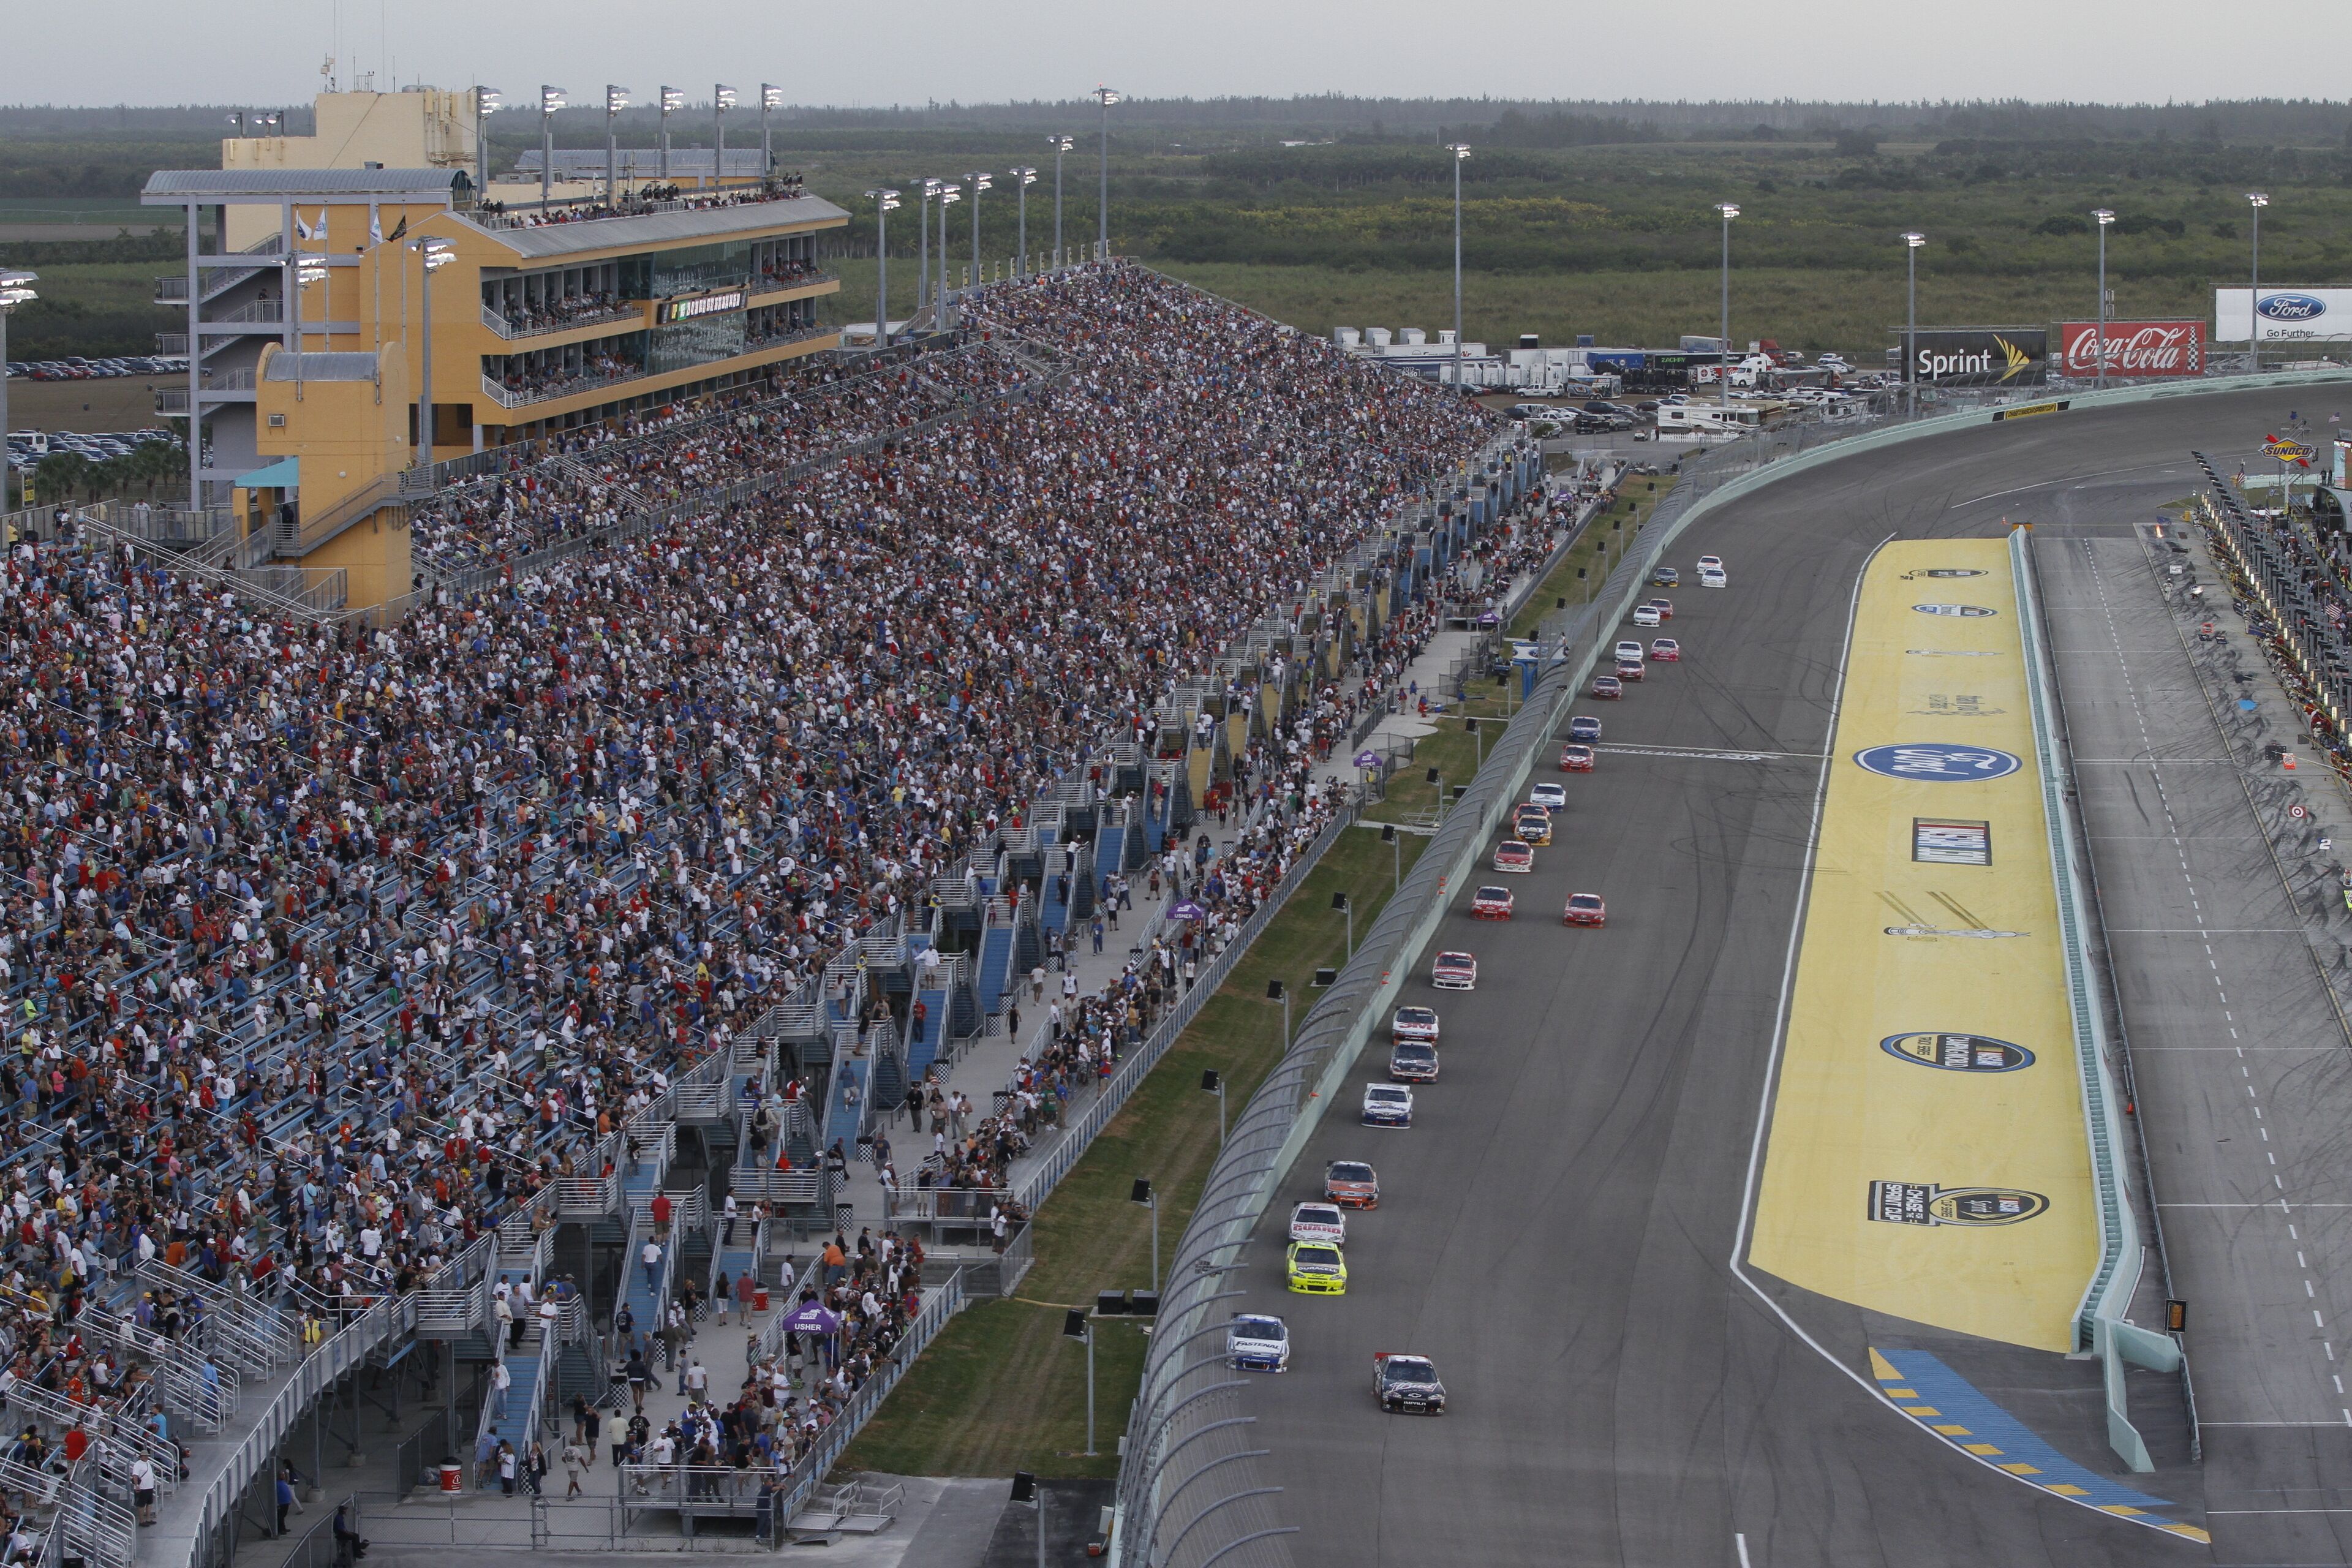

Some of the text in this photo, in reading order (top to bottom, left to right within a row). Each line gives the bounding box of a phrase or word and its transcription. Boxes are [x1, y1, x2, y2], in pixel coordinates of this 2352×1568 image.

[2269, 296, 2312, 318] Ford
[2068, 328, 2186, 370] Coca-Cola
[1918, 349, 1991, 380] Sprint
[2265, 447, 2310, 456] SUNOCO
[1891, 749, 1997, 775] Ford
[2319, 839, 2332, 850] 2
[1917, 1036, 1932, 1055] TRUCK SERIES
[1944, 1036, 1969, 1067] CAMPING WORLD
[1977, 1051, 2003, 1066] NASCAR
[1885, 1184, 1902, 1221] SPRINT CUP
[1905, 1189, 1923, 1212] CHASE
[1964, 1200, 1992, 1213] Sprint
[1999, 1200, 2019, 1213] NASCAR
[1941, 1207, 1953, 1218] SERIES
[1293, 1224, 1341, 1234] GUARD
[1235, 1341, 1280, 1350] FASTENAL
